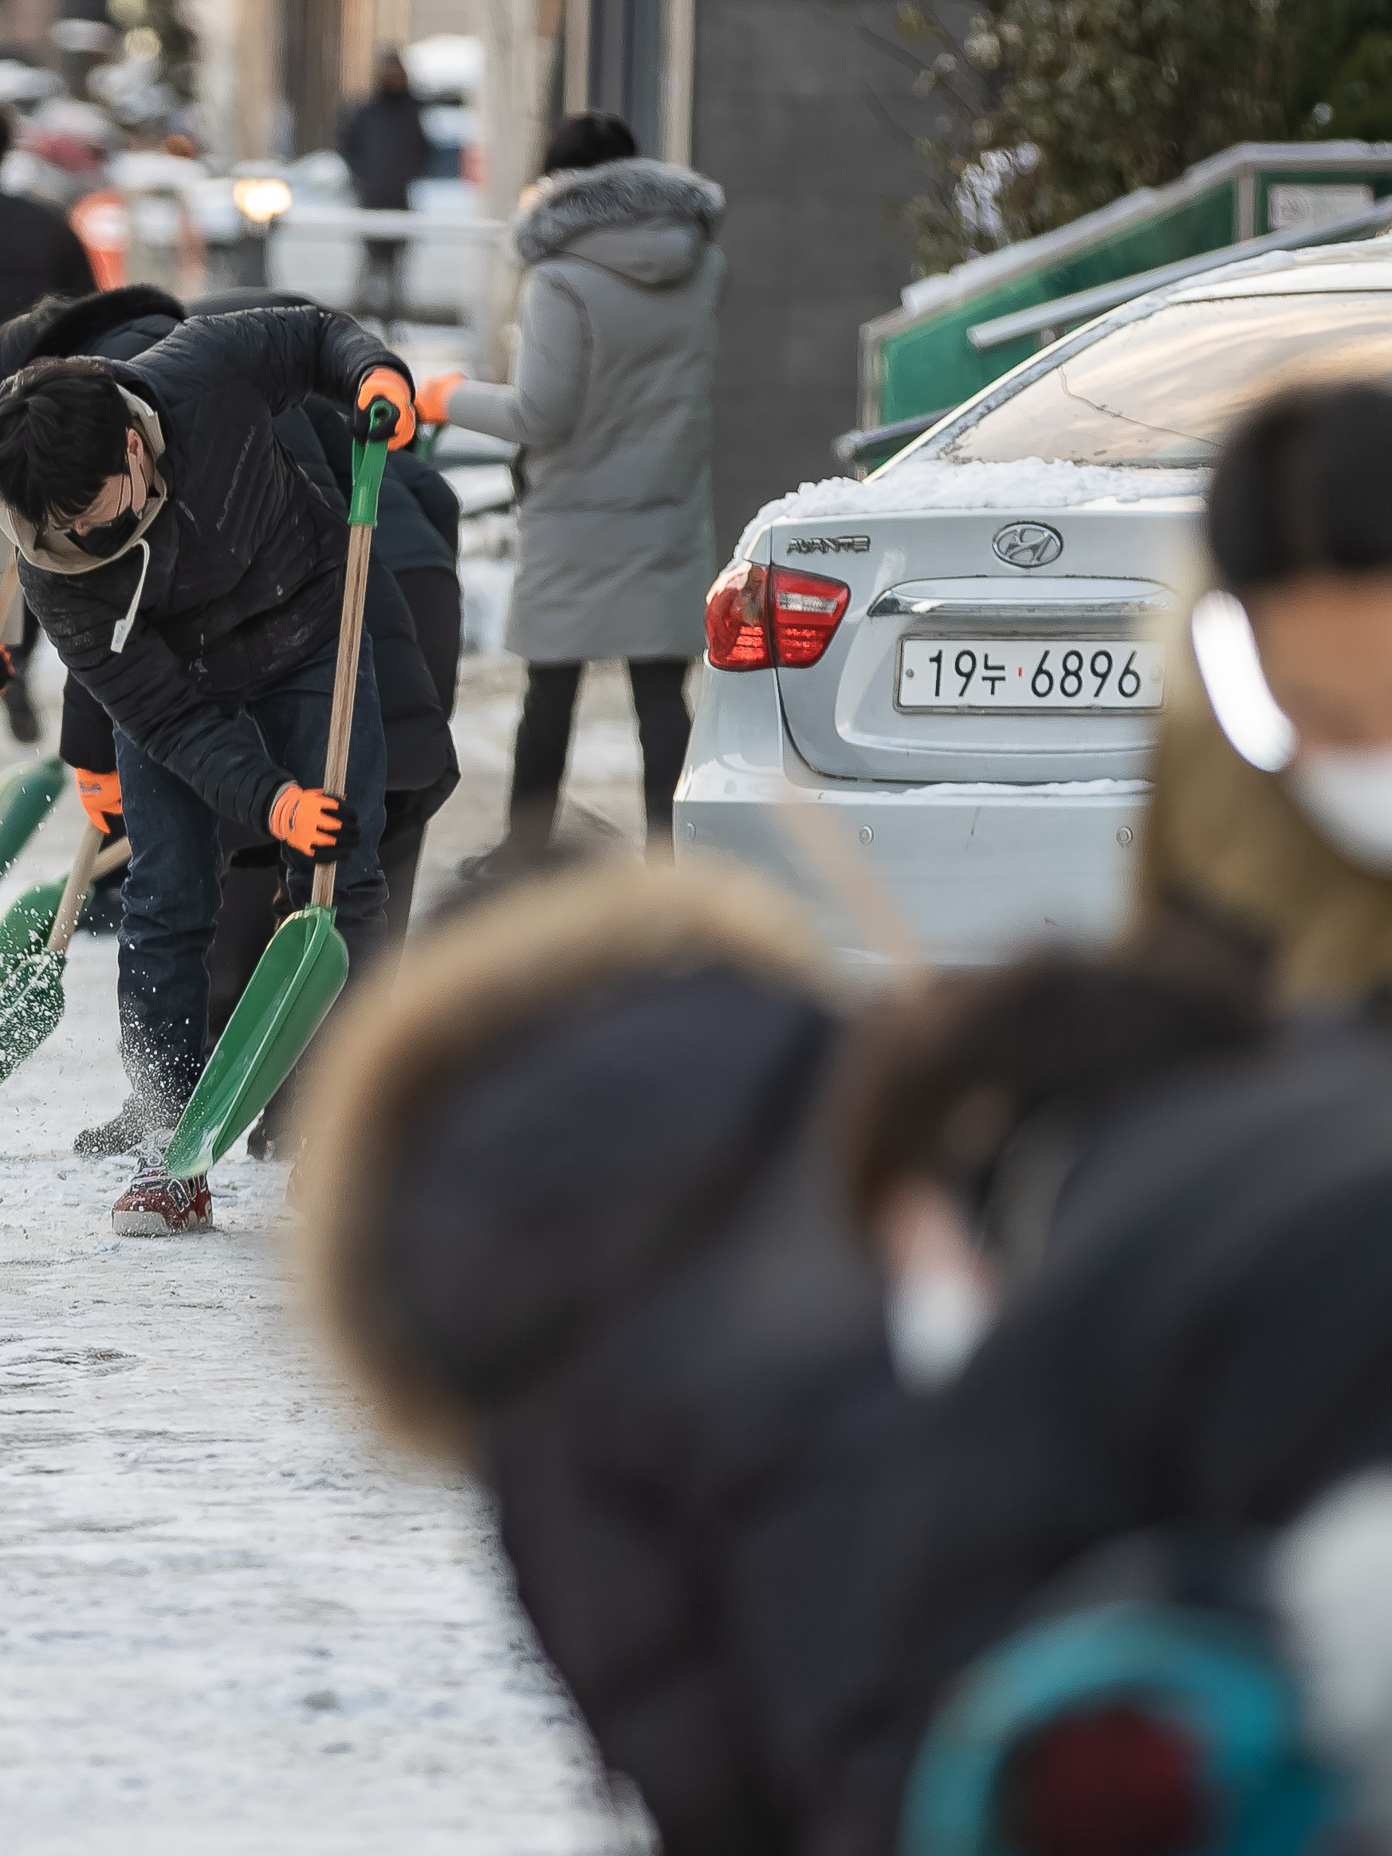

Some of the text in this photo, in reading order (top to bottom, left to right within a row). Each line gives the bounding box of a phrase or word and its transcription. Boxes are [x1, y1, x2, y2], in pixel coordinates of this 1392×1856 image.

[786, 534, 871, 555] AVANTE
[928, 649, 1142, 698] 19누 6896
